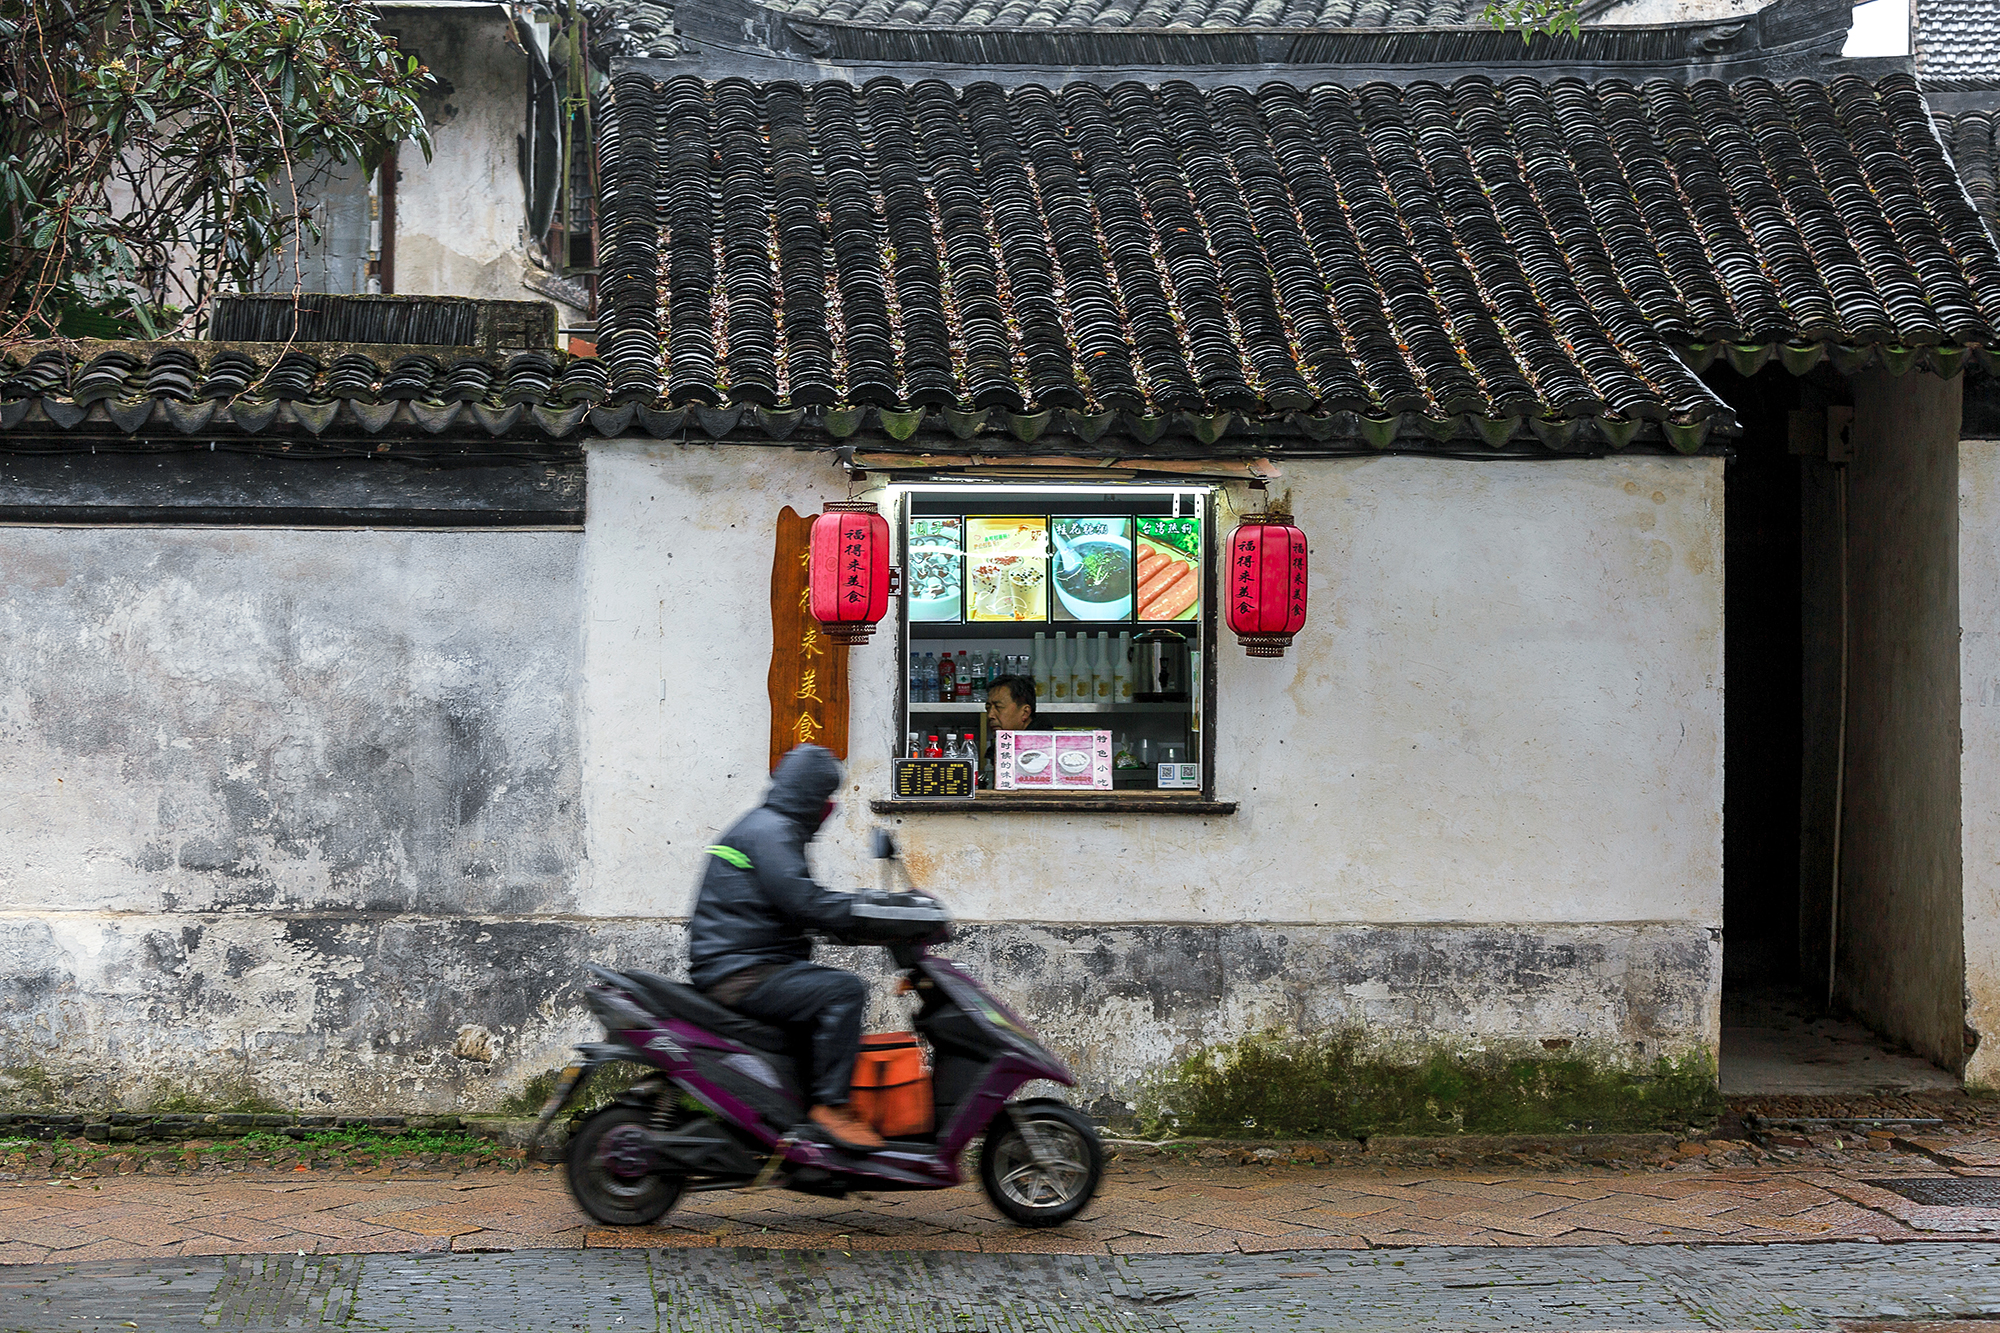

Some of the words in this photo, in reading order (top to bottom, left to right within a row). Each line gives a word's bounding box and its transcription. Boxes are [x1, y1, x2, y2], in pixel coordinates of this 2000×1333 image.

[1142, 521, 1193, 535] 台湾热狗
[843, 529, 867, 604] 福得来美食
[1235, 540, 1256, 615] 福得来美食
[1291, 542, 1305, 617] 福得来美食
[1000, 732, 1012, 789] 小时候的味道
[1096, 735, 1109, 787] 特色小吃
